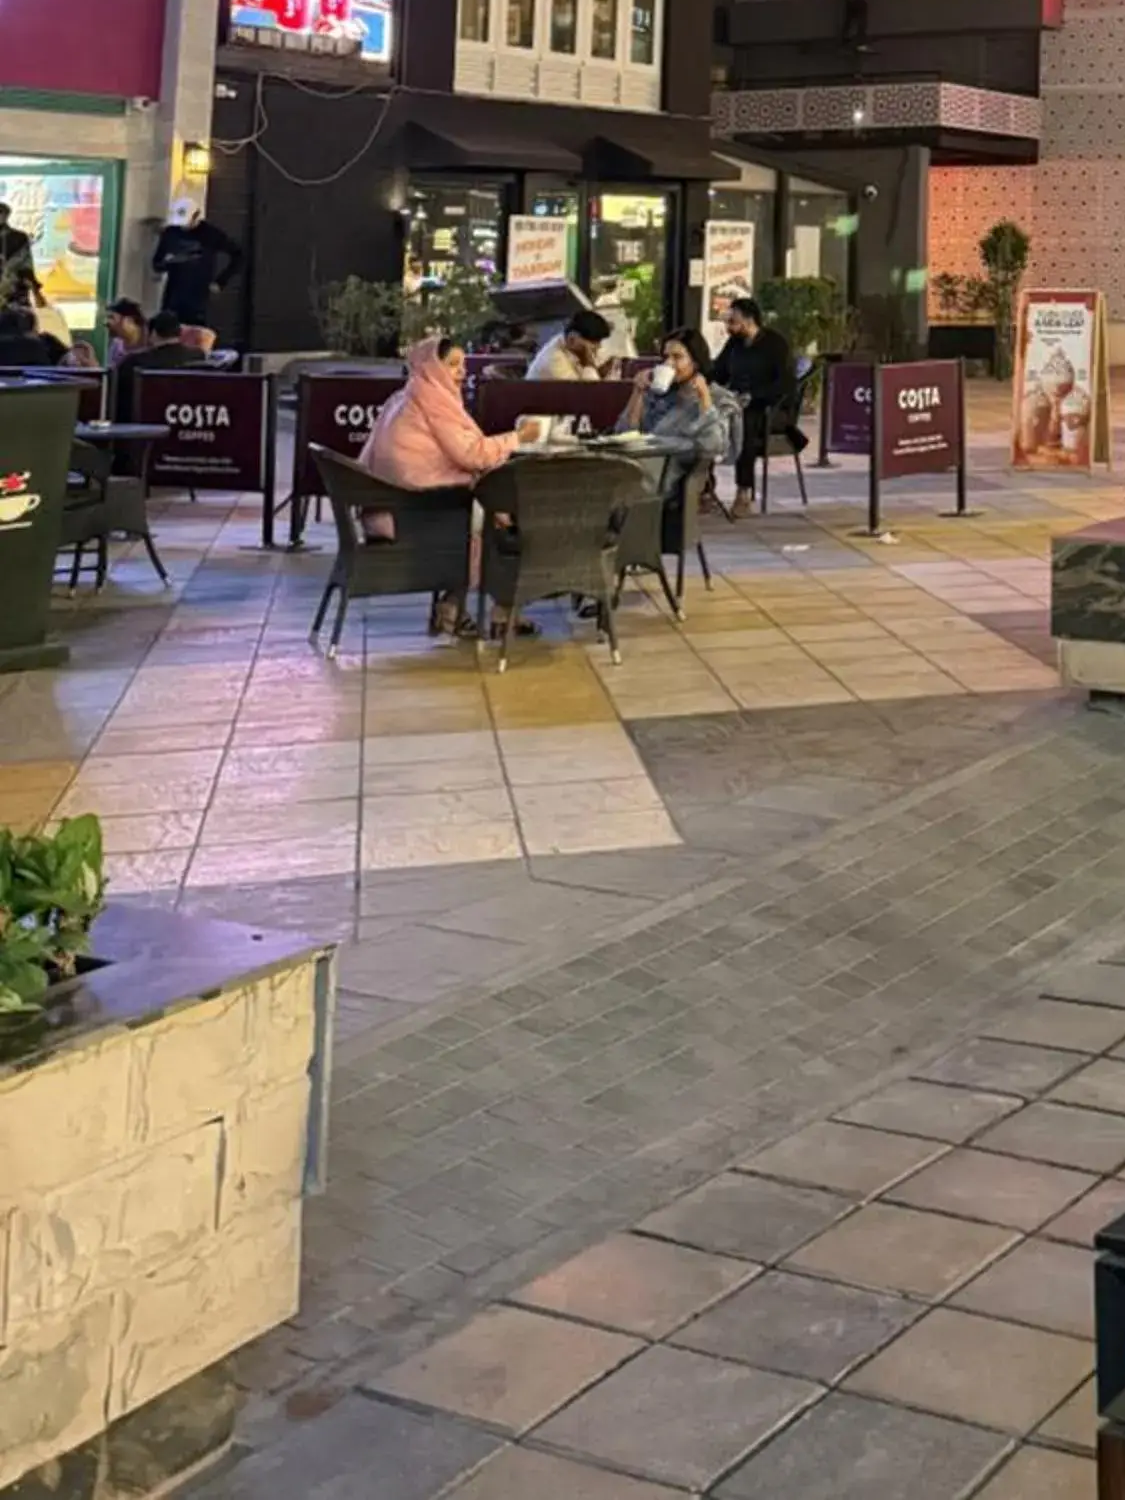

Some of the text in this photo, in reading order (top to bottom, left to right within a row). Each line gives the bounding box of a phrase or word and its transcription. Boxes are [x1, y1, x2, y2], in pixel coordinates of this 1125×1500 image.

[898, 386, 942, 409] COSTA
[165, 404, 231, 427] COSTA
[333, 404, 384, 428] COS
